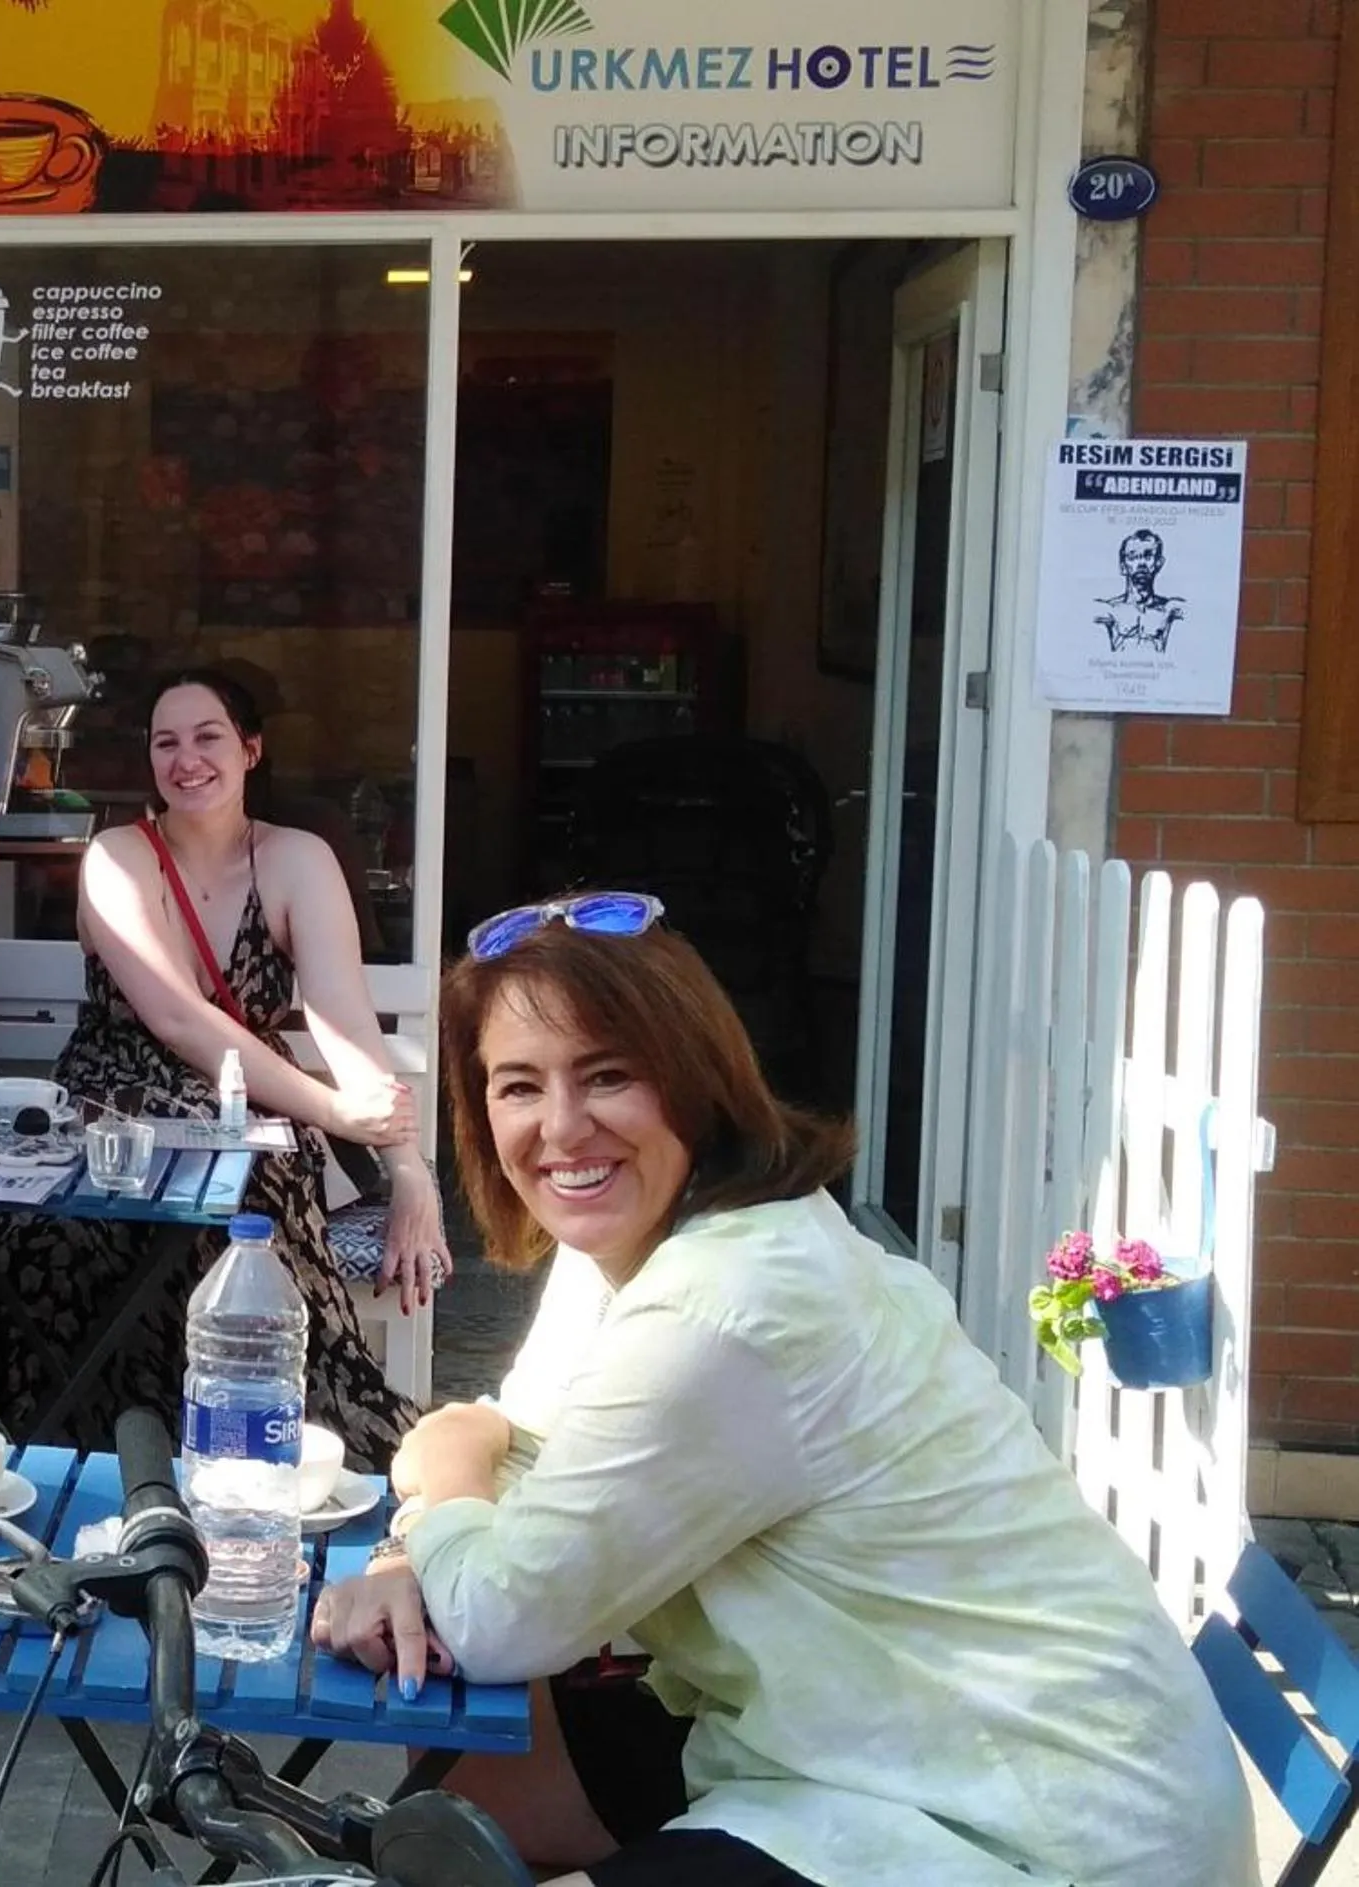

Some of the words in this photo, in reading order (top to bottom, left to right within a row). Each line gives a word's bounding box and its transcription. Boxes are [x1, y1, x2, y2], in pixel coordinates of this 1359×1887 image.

[531, 47, 753, 93] URKMEZ
[768, 44, 942, 92] HOTEL
[553, 121, 925, 168] INFORMATION
[31, 282, 163, 302] cappuccino
[31, 306, 124, 323] espresso
[30, 324, 75, 341] filter
[81, 324, 150, 341] coffee
[30, 344, 64, 360] ice
[70, 344, 139, 361] coffee
[30, 365, 67, 380] tea
[30, 380, 132, 398] breakfast
